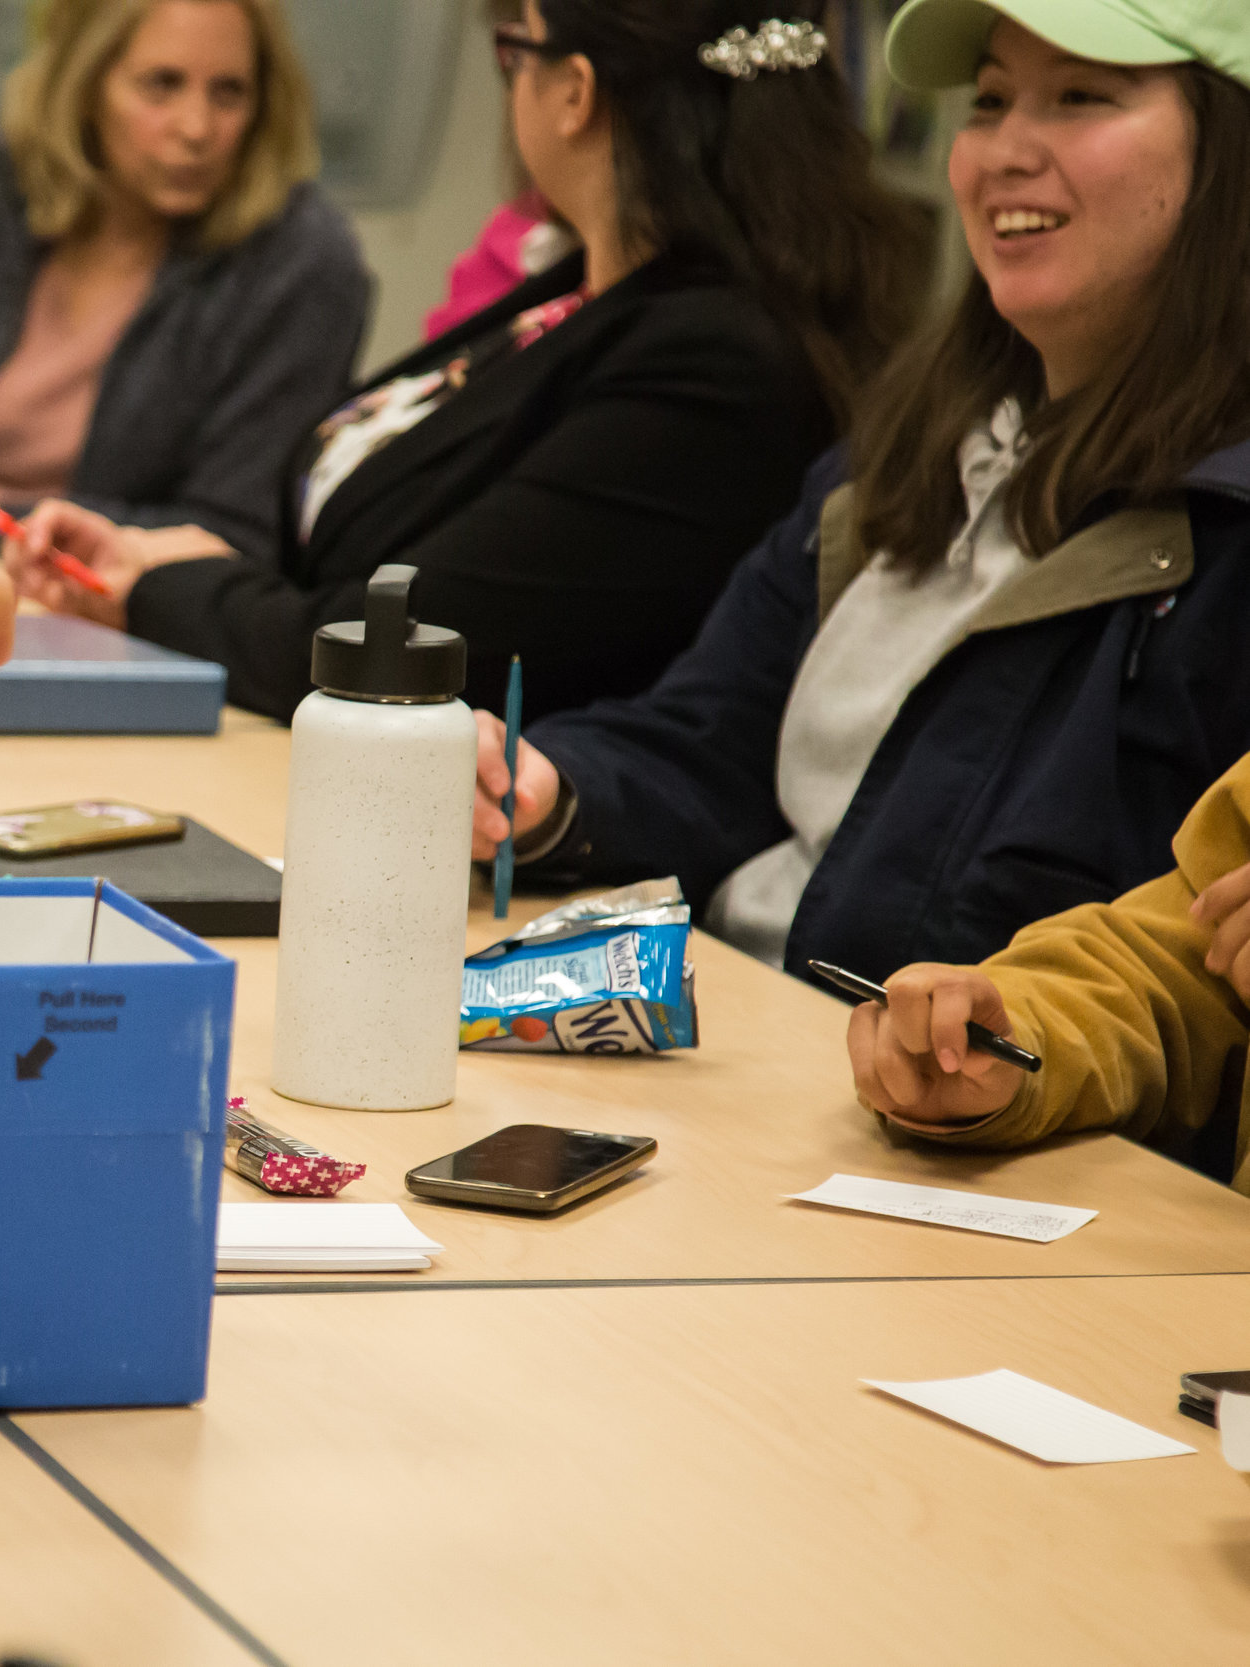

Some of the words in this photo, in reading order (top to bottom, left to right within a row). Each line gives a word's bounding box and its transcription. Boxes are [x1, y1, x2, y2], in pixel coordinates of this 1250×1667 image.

[612, 935, 633, 989] Welch's
[39, 990, 75, 1008] Pull
[79, 990, 126, 1008] Here
[44, 1014, 118, 1032] Second
[570, 1000, 630, 1054] We
